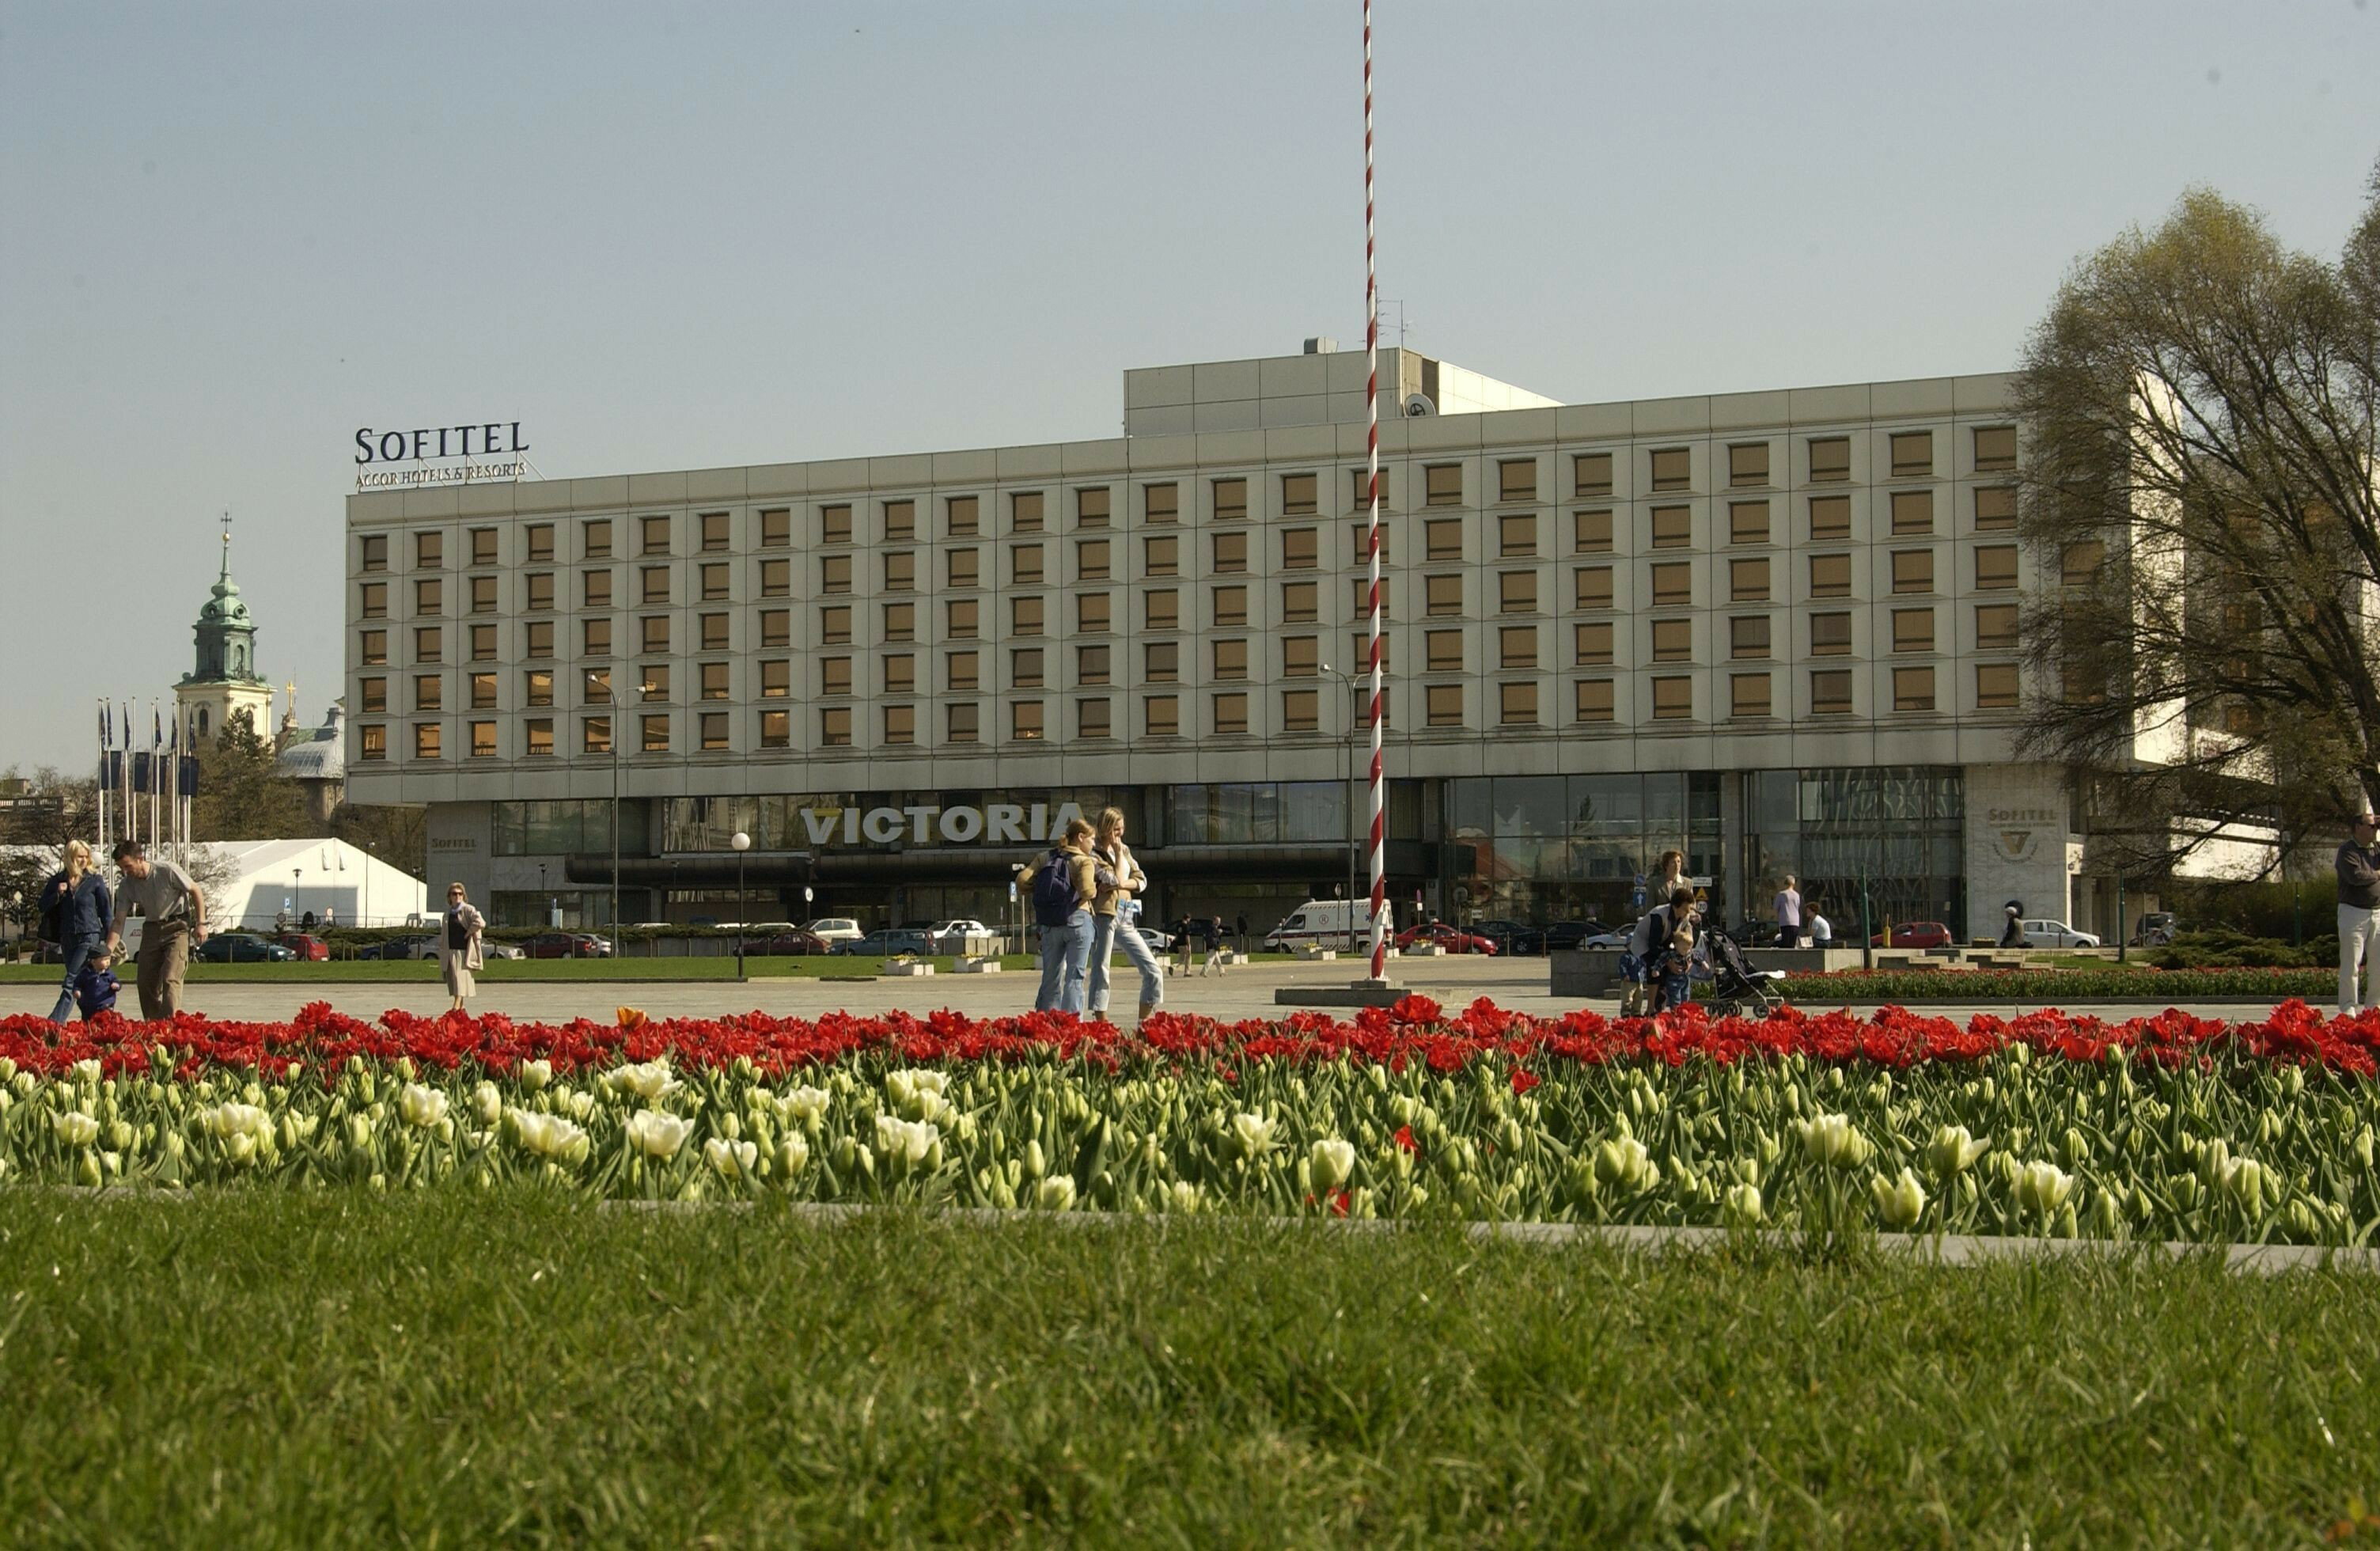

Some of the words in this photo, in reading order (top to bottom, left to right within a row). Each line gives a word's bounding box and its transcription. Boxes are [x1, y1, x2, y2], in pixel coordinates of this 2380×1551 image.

[355, 422, 530, 464] SOFITEL
[356, 472, 398, 487] ACCOR
[401, 468, 452, 482] HOTELS
[453, 467, 464, 480] &
[466, 463, 527, 479] RESORTS
[801, 802, 1086, 844] VICTORIA
